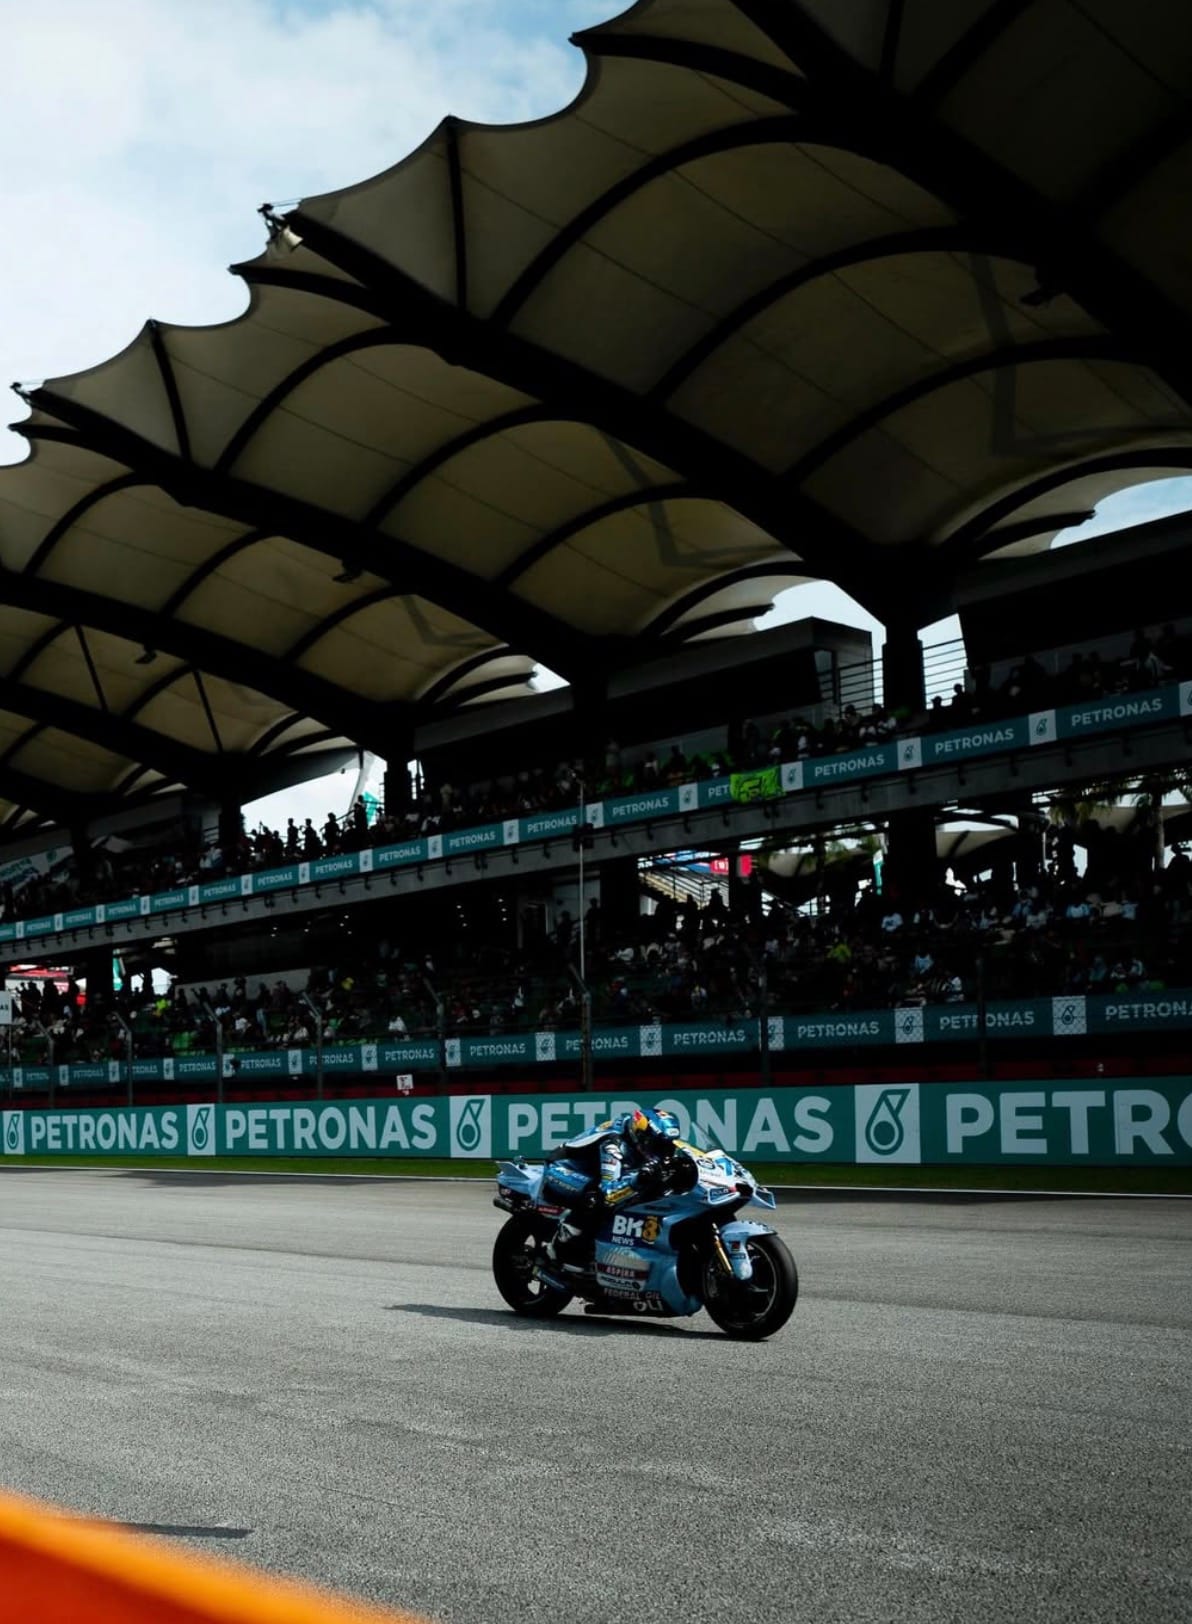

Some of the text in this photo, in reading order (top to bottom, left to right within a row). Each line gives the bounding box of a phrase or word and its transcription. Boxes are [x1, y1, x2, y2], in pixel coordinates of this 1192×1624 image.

[257, 872, 293, 886] PETRONAS
[315, 859, 353, 874] PETRONAS
[379, 846, 421, 862] PETRONAS
[449, 831, 496, 848] PETRONAS
[527, 815, 577, 833] PETRONAS
[612, 797, 669, 817] PETRONAS
[814, 753, 885, 777] PETRONAS
[934, 727, 1014, 754] PETRONAS
[1071, 697, 1163, 727] PETRONAS
[385, 1049, 434, 1061] PETRONAS
[470, 1044, 526, 1057] PETRONAS
[565, 1036, 628, 1051] PEONAS
[673, 1030, 746, 1045] PETRONAS
[797, 1021, 880, 1038] PETRONAS
[31, 1112, 179, 1150] PETRONAS
[225, 1104, 437, 1150] PETRONAS
[946, 1089, 1192, 1155] PETR
[611, 1235, 635, 1246] NEWS
